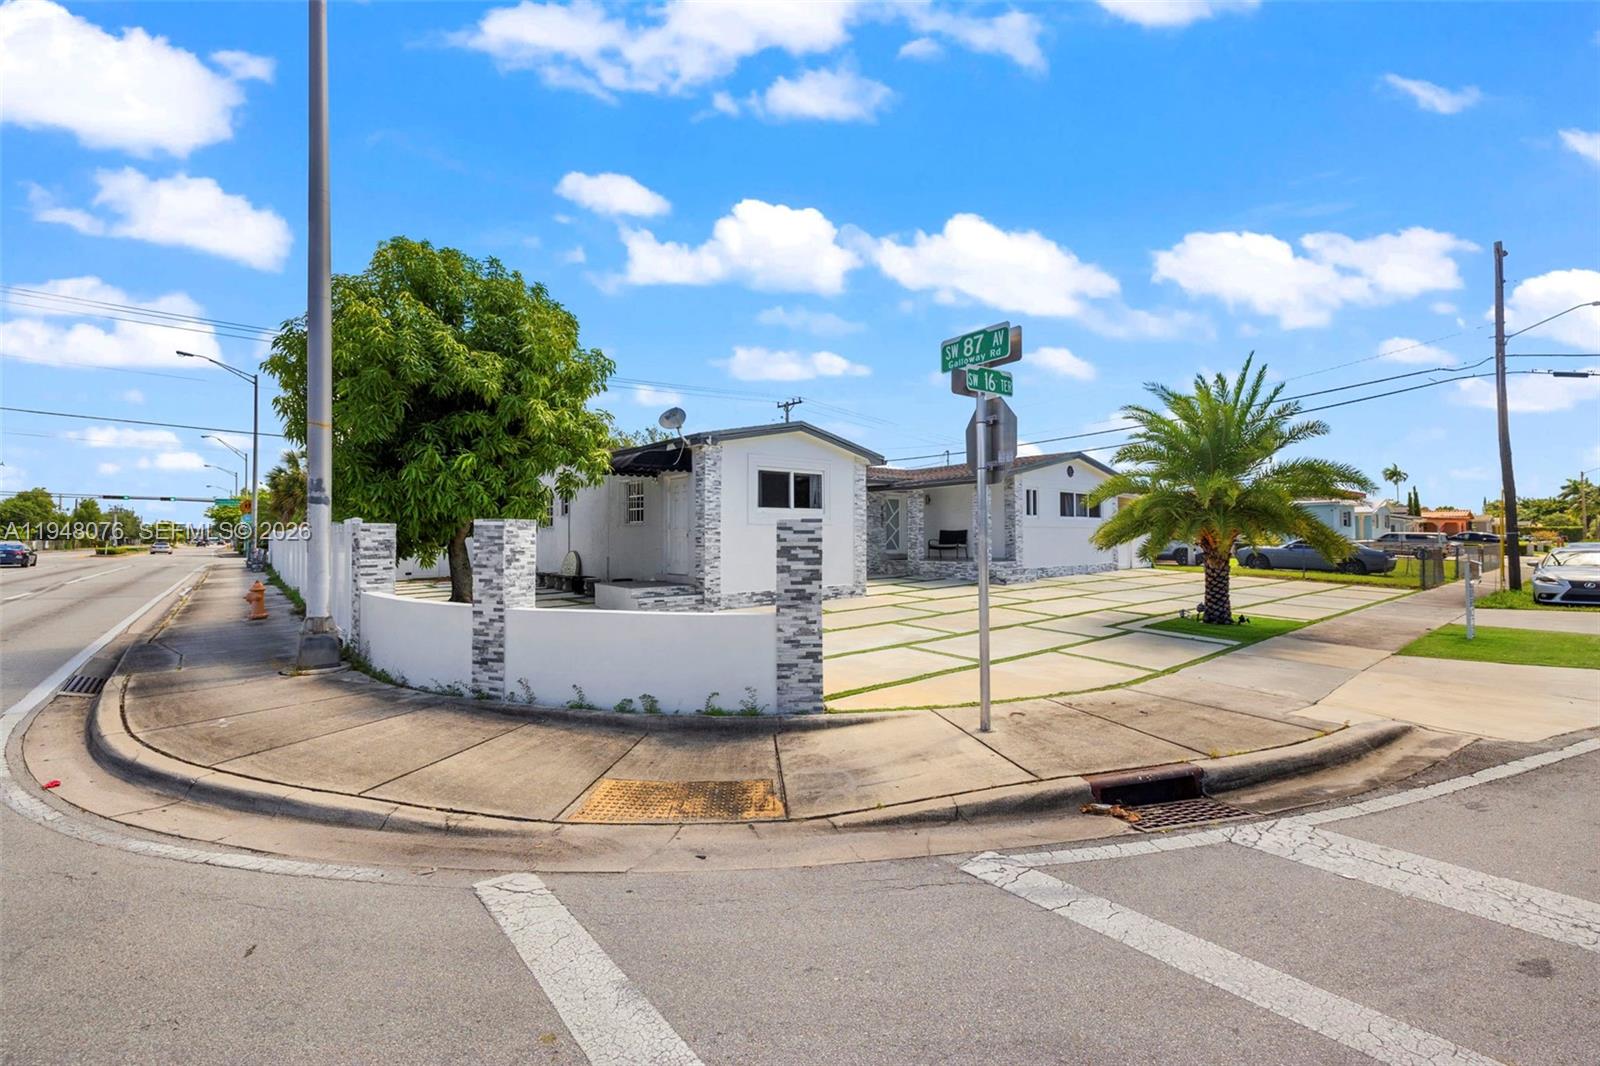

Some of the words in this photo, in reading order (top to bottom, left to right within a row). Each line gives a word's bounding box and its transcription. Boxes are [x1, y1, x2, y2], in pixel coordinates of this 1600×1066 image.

[945, 343, 959, 360] SW
[963, 334, 984, 357] 87
[992, 329, 1004, 347] AV
[948, 352, 986, 368] Galloway
[990, 348, 1001, 358] Rd
[968, 372, 978, 387] SW
[984, 372, 996, 391] 16
